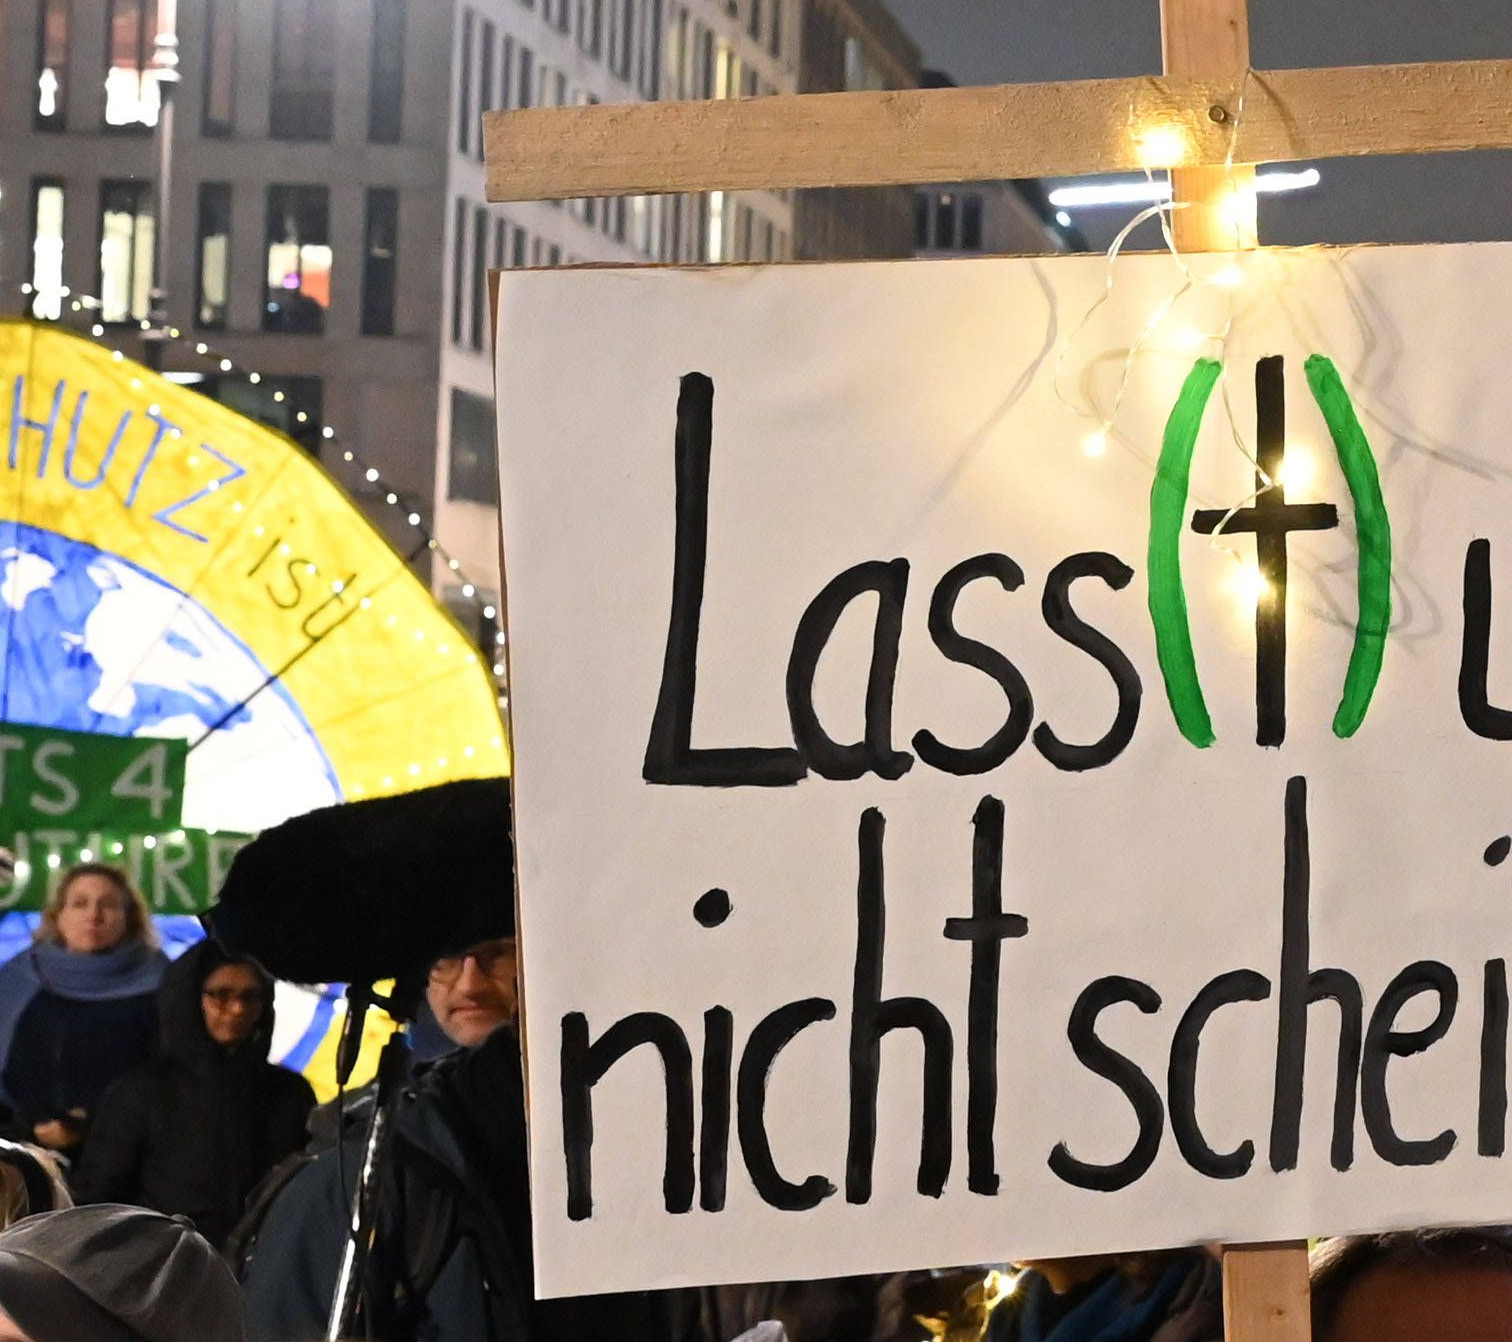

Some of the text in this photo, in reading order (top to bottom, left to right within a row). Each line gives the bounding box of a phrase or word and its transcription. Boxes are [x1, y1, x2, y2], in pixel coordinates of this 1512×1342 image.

[110, 742, 173, 820] 4
[641, 353, 1393, 789] Lass(t)
[560, 794, 1029, 1222] nicht
